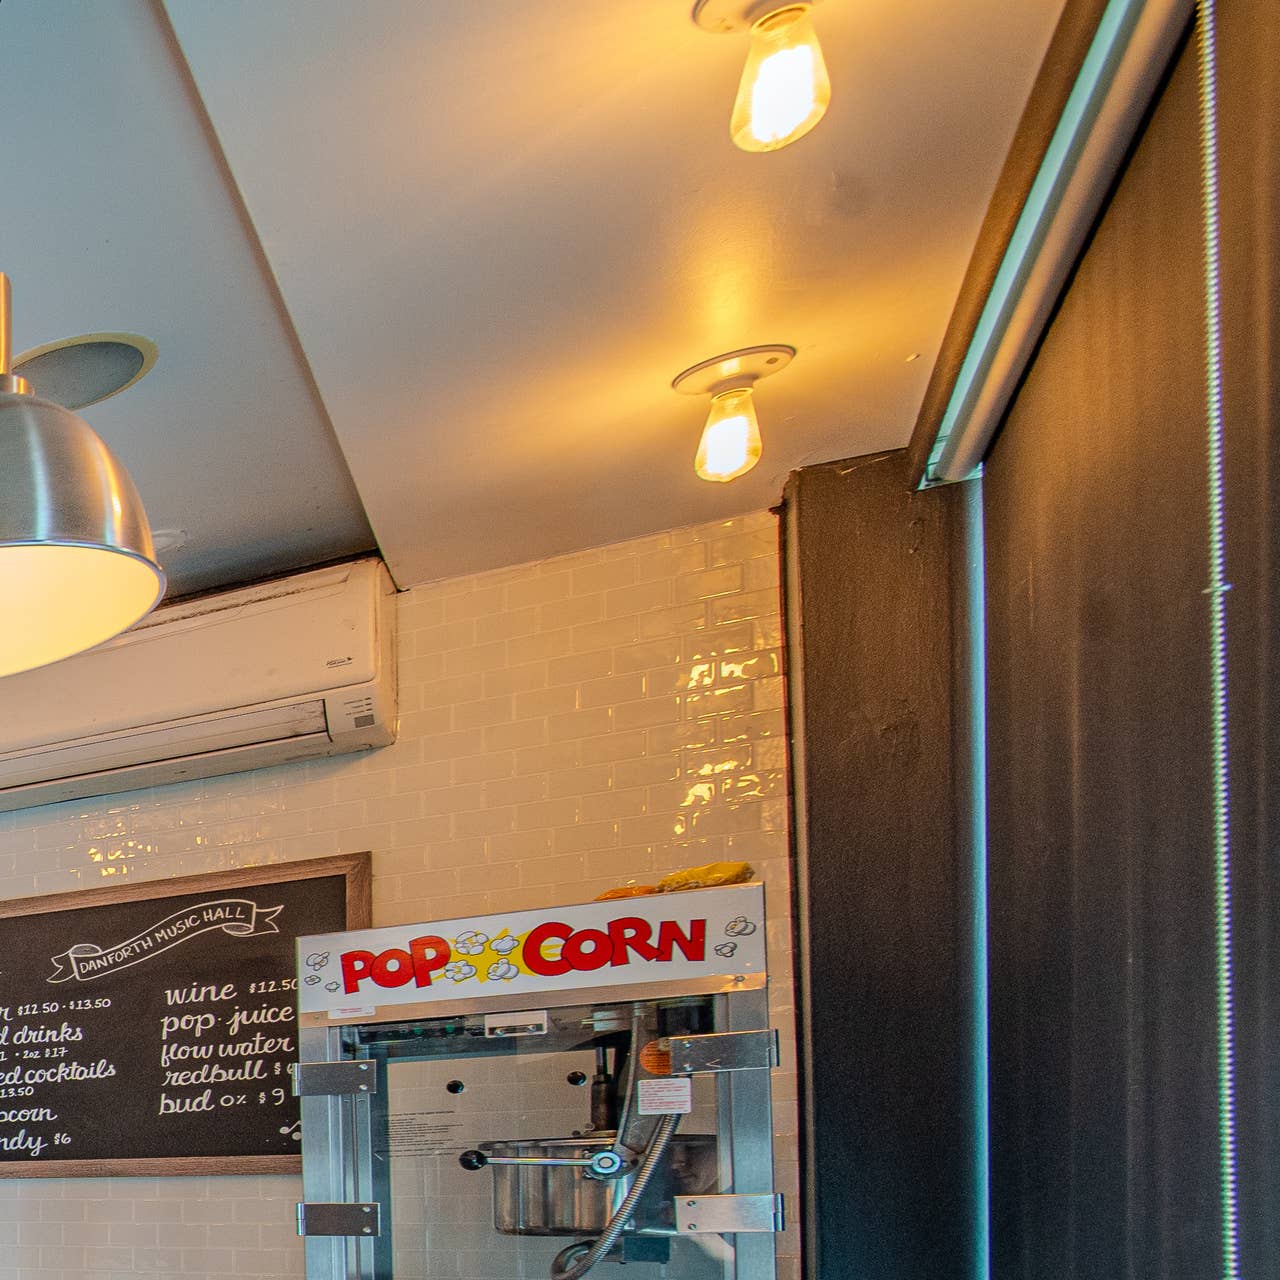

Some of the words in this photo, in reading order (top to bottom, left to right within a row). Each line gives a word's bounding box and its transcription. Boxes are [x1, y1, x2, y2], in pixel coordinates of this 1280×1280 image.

[79, 937, 153, 973] DANFORTH
[155, 915, 201, 943] MUSIC
[203, 907, 246, 922] HALL
[340, 934, 451, 994] POP
[522, 917, 705, 977] CORN
[164, 982, 237, 1005] wine
[17, 1002, 59, 1016] $12.50
[69, 999, 111, 1010] $13.50
[13, 1022, 83, 1045] drinks
[160, 1014, 215, 1040] pop
[227, 1004, 295, 1035] juice
[44, 1047, 69, 1058] $17
[161, 1044, 214, 1067] flow
[218, 1032, 295, 1057] water
[25, 1059, 116, 1083] cocktails
[162, 1060, 268, 1087] redbull
[159, 1089, 215, 1115] bud
[54, 1133, 71, 1144] $6
